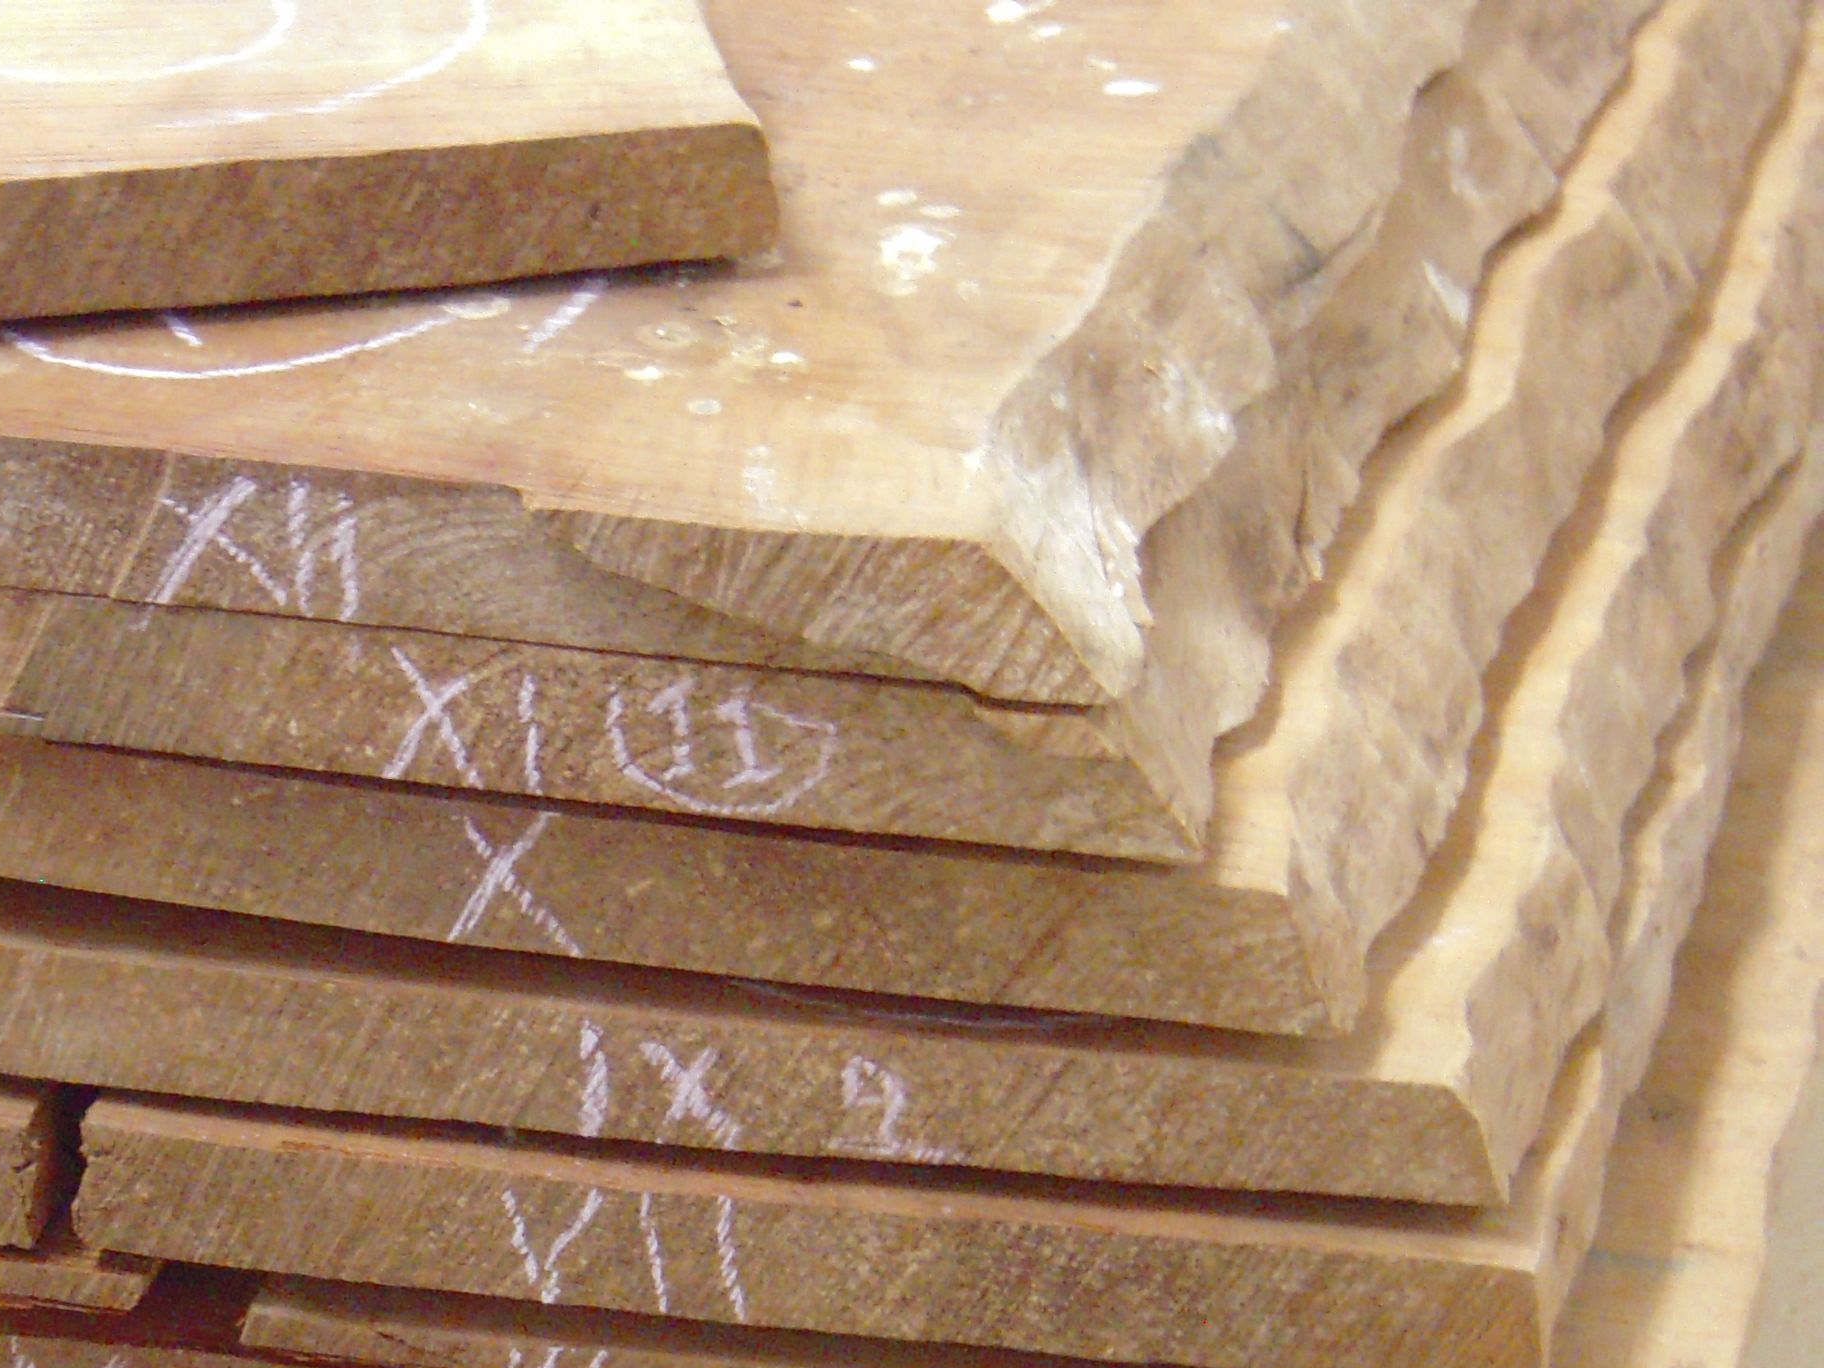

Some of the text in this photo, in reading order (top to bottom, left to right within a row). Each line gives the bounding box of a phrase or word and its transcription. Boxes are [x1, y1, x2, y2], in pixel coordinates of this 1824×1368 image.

[382, 646, 544, 796] XI
[447, 810, 583, 958] X
[578, 1018, 743, 1151] IX
[500, 1187, 747, 1322] VII
